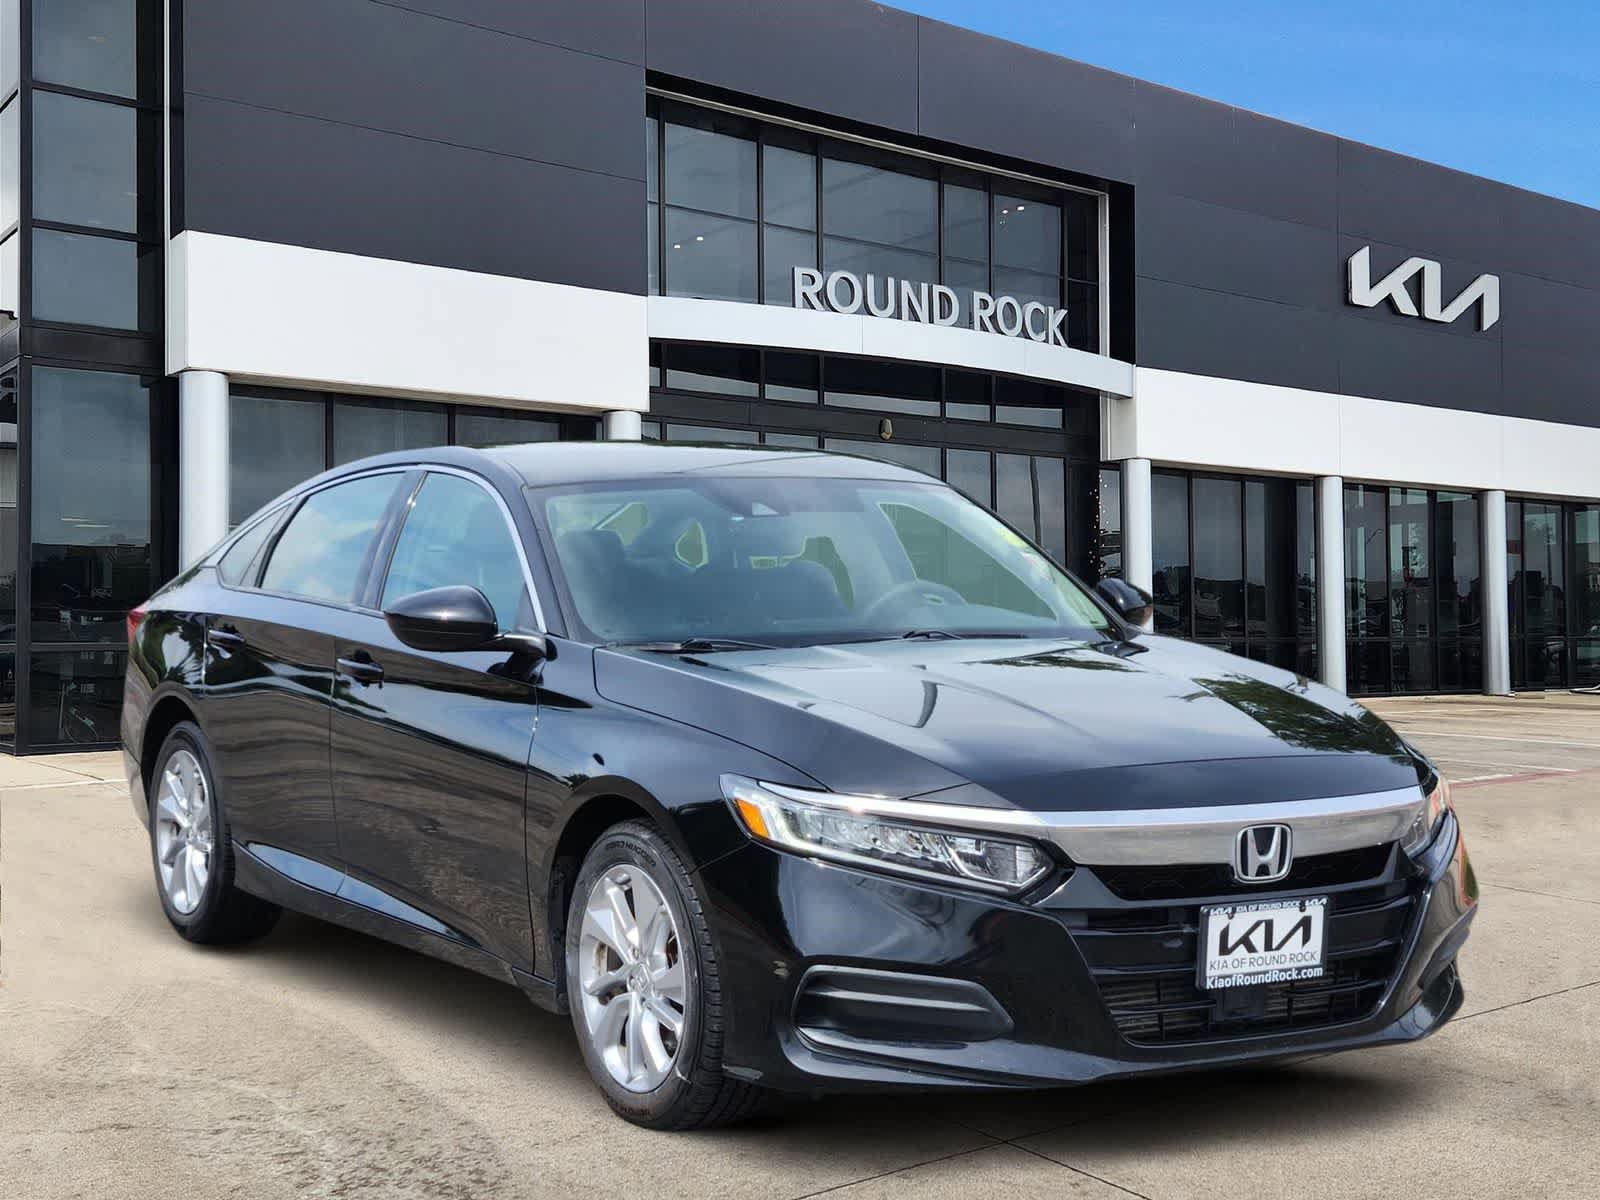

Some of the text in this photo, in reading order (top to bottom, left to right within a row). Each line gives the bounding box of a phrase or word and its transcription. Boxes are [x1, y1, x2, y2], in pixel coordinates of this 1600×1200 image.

[792, 266, 1069, 348] ROUND ROCK
[1348, 245, 1500, 331] KIA
[1219, 915, 1312, 956] KIA
[1206, 967, 1323, 990] KiaofRoundRock.com
[1209, 951, 1317, 971] KIA OF ROUND ROCK
